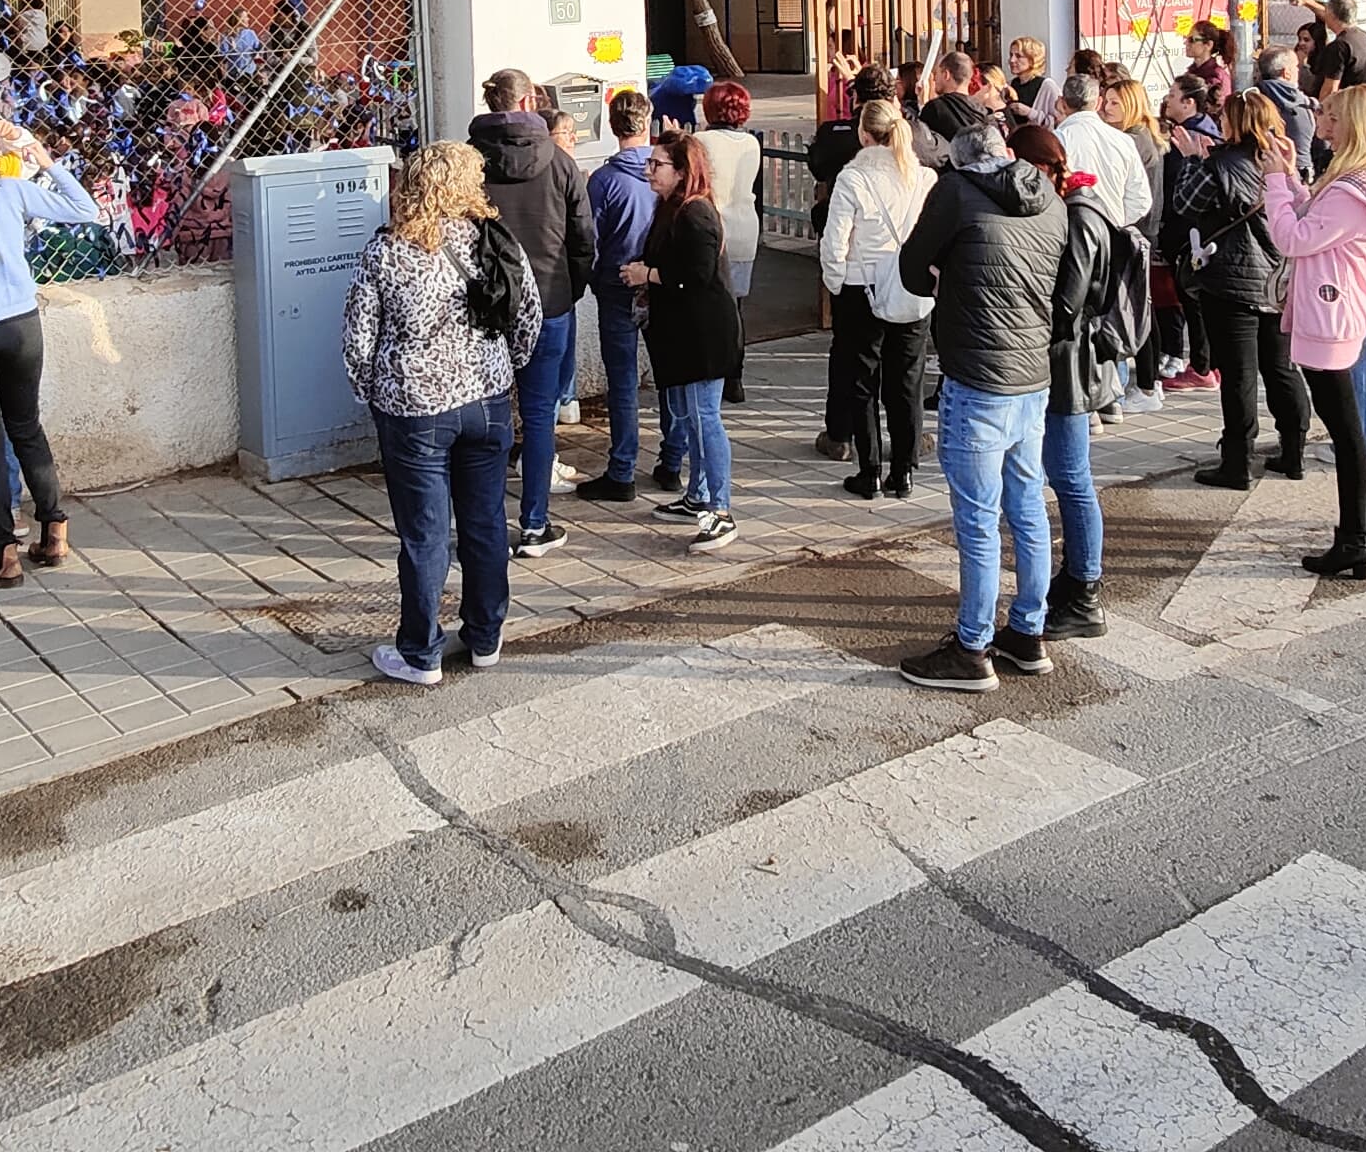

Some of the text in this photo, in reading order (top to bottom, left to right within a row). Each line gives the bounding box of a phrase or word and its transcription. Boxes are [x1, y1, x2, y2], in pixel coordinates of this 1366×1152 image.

[556, 1, 576, 21] 50
[335, 178, 379, 195] 9941
[284, 251, 364, 268] PROHIBIDO CARTELE
[319, 262, 354, 274] ALICANTE
